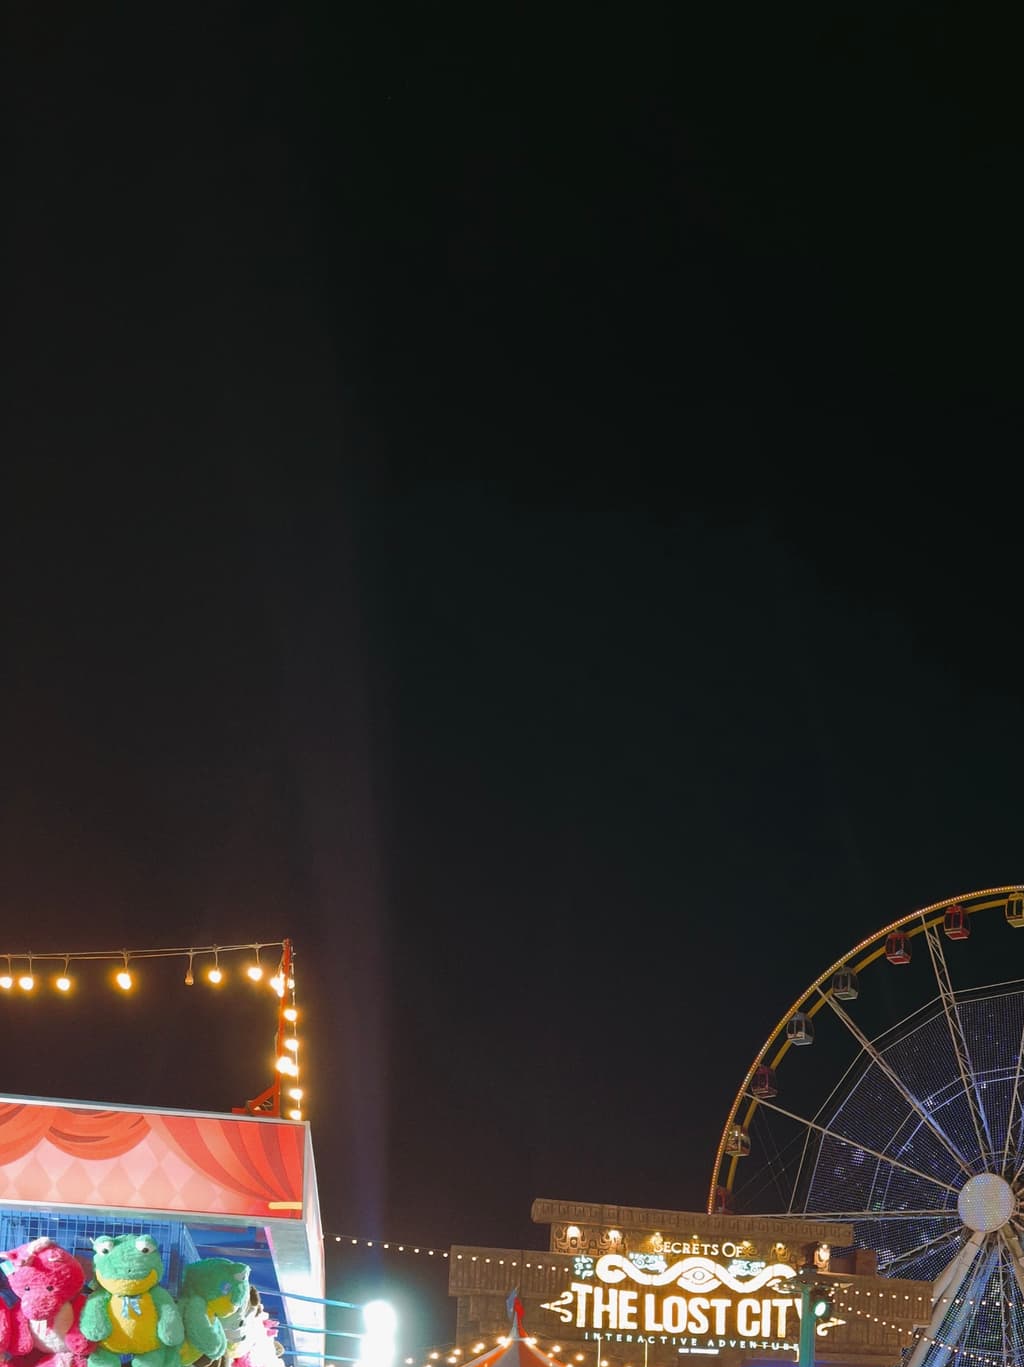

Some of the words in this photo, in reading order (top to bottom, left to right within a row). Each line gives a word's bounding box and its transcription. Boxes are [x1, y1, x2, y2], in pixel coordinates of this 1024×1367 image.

[654, 1241, 719, 1256] SECRETS
[571, 1282, 638, 1330] THE
[645, 1294, 731, 1336] LOST
[585, 1332, 697, 1346] INTERACTIVE
[708, 1340, 799, 1351] ADVENTURE
